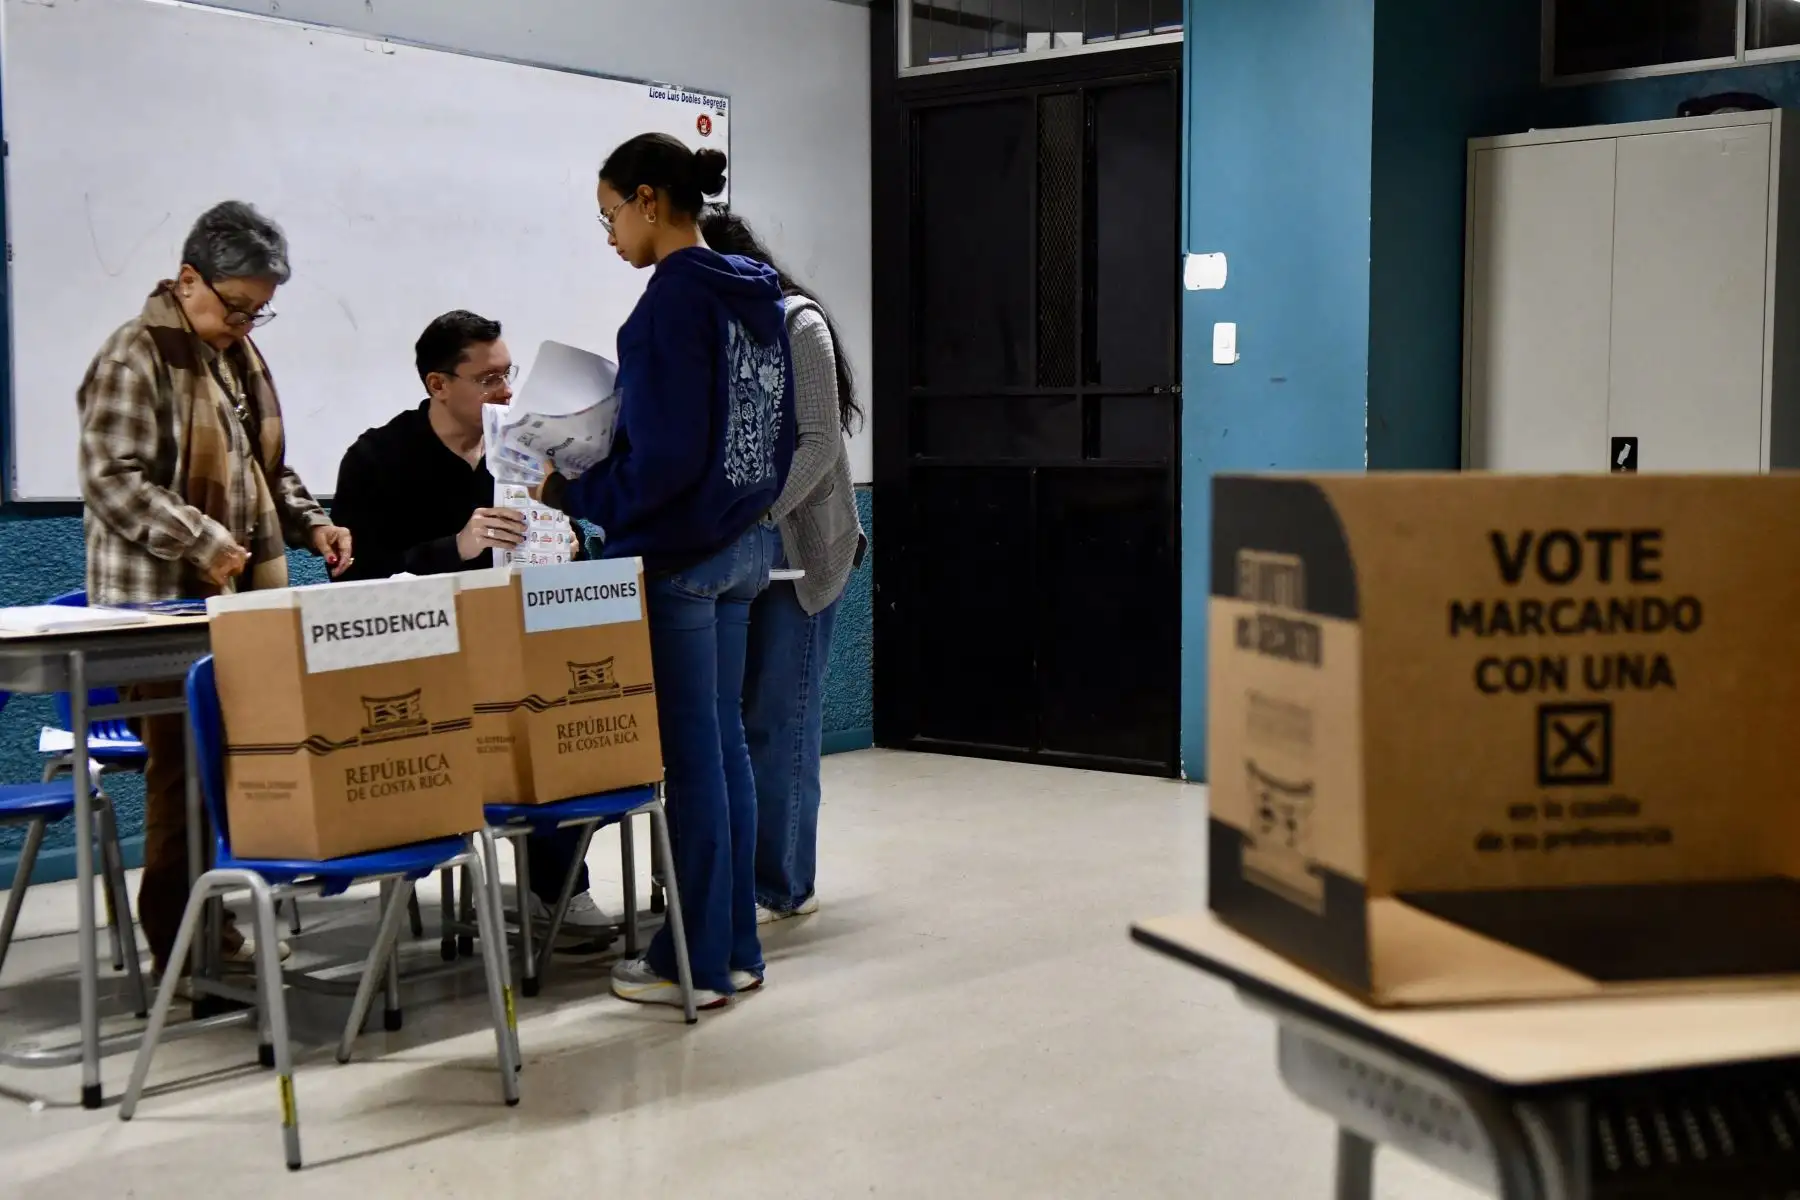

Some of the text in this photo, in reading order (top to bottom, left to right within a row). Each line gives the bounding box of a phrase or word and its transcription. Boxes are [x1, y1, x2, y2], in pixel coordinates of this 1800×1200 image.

[649, 88, 665, 99] Liceo
[667, 90, 680, 102] Luis
[681, 93, 700, 104] Dobles
[1489, 528, 1664, 586] VOTE
[527, 582, 637, 607] DIPUTACIONES
[312, 609, 450, 643] PRESIDENCIA
[1449, 596, 1703, 637] MARCANDO
[1474, 652, 1676, 694] CON UNA
[556, 713, 637, 739] REPÚBLICA
[558, 731, 639, 754] DE COSTA RICA
[345, 753, 450, 786] REPÚBLICA
[346, 773, 452, 802] DE COSTA RICA
